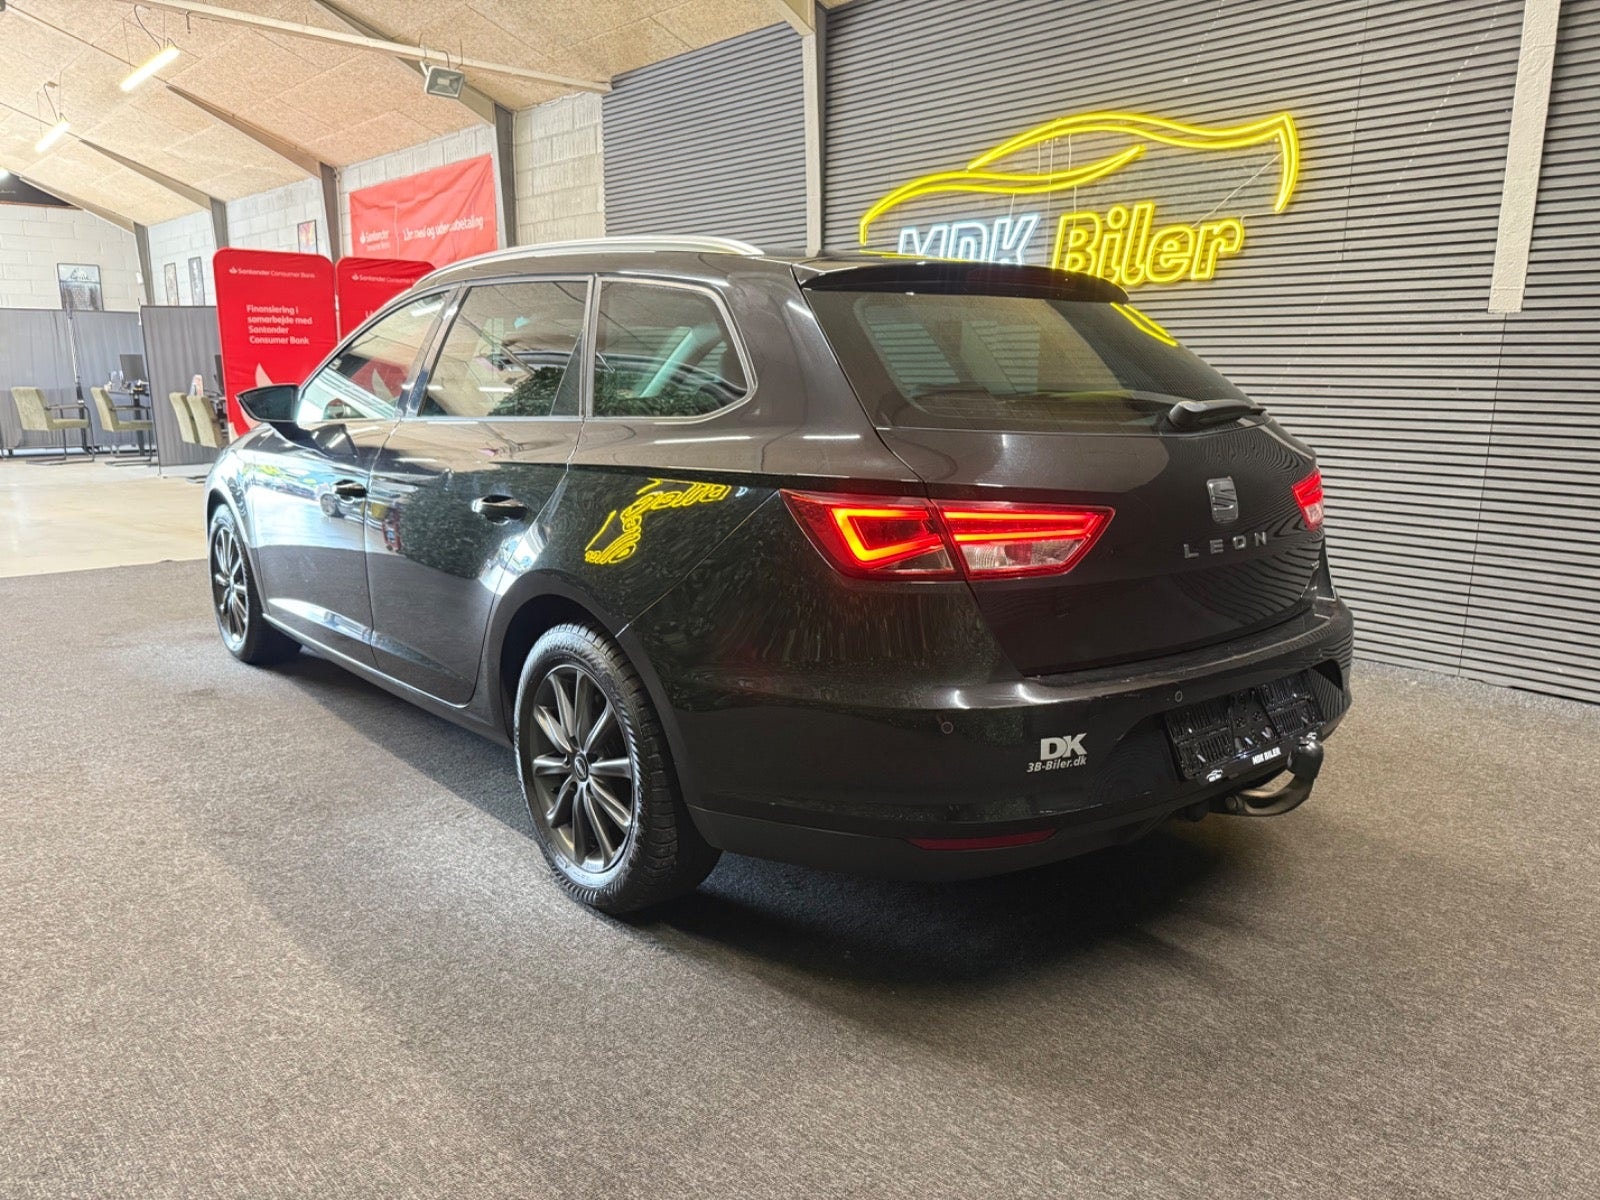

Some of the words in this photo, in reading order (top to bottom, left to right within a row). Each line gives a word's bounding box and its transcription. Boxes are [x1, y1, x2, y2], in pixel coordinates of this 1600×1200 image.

[1051, 201, 1245, 286] Biler
[238, 267, 270, 277] Santander
[270, 269, 300, 278] Consumer
[359, 273, 386, 283] Santander
[246, 304, 295, 316] Finansiering
[247, 315, 294, 326] samarbejde
[295, 316, 313, 325] med
[248, 325, 290, 334] Santander
[249, 335, 289, 344] Consumer
[289, 336, 310, 345] Bank
[1183, 531, 1268, 559] LEON
[1040, 732, 1088, 761] DK
[1026, 755, 1087, 773] 3B-Biler.dk
